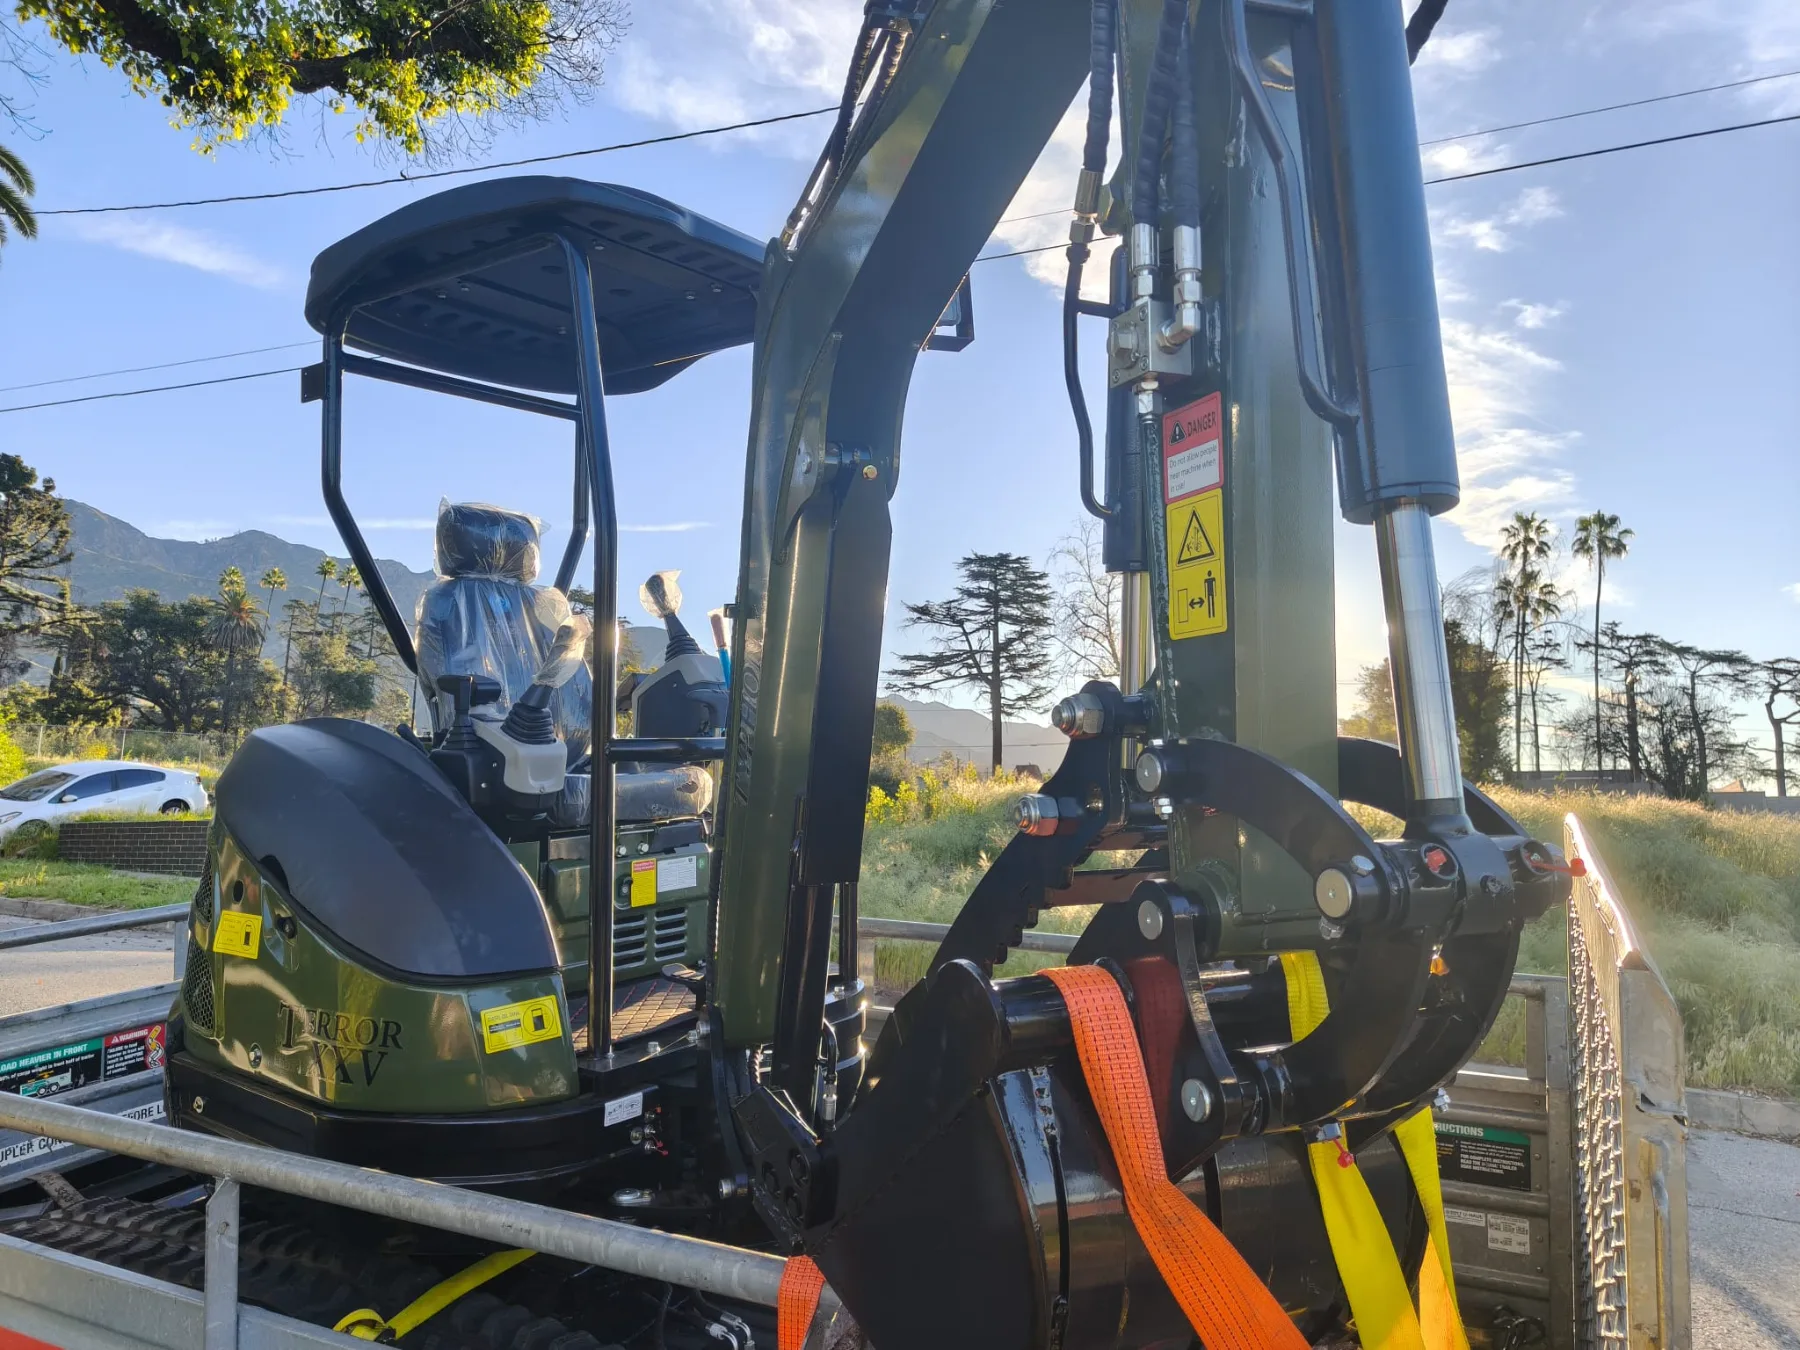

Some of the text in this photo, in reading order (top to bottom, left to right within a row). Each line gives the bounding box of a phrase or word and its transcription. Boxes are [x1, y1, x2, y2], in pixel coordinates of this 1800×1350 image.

[1187, 412, 1216, 437] DANGER
[1169, 444, 1217, 468] Do not allow people
[1170, 458, 1216, 480] near machine when
[119, 1029, 148, 1041] WARNING
[278, 1000, 404, 1050] TERROR
[0, 1044, 88, 1073] OAD HEAVIER IN FRONT
[305, 1041, 389, 1087] XXV
